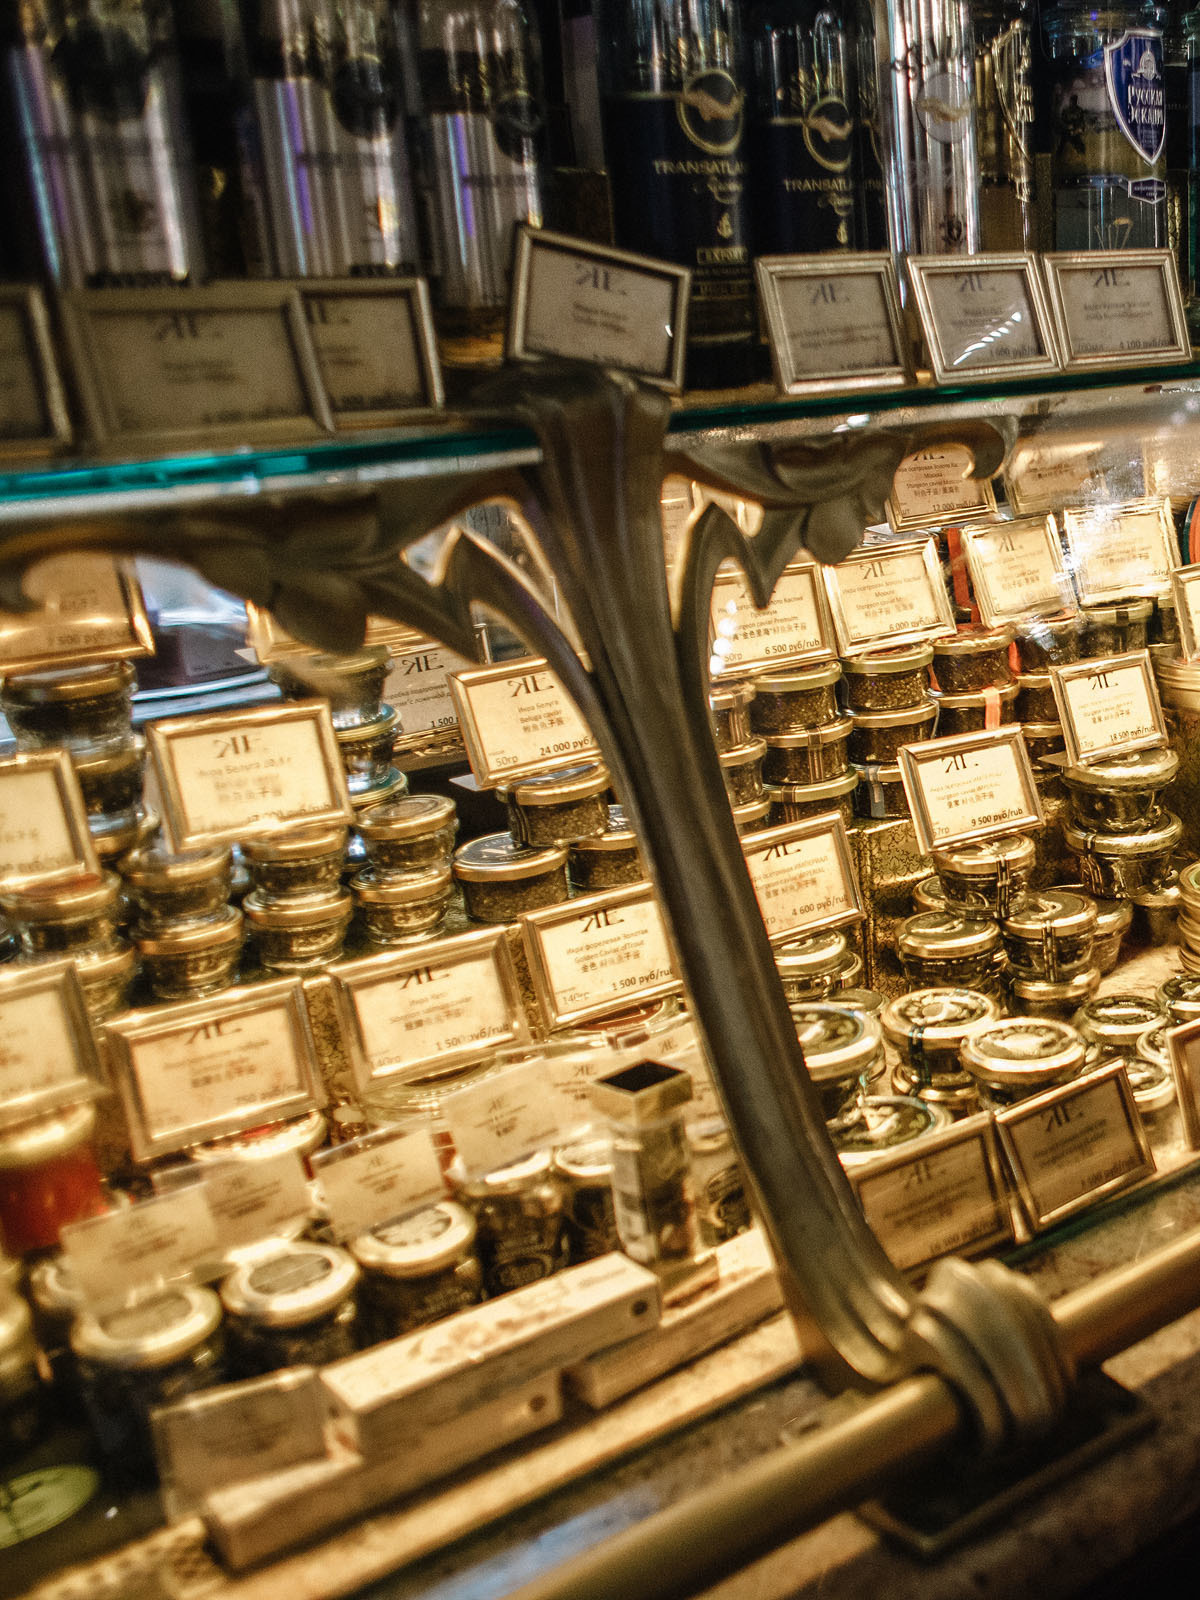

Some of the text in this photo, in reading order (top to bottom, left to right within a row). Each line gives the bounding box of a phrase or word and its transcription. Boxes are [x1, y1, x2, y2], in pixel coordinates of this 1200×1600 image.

[764, 639, 820, 655] 6 500 руб/rub
[438, 716, 454, 727] 500
[539, 735, 595, 757] 24 000 руб/
[971, 818, 977, 828] 9
[978, 814, 992, 826] 500
[799, 903, 815, 914] 600
[611, 982, 618, 991] 1
[619, 976, 637, 989] 500
[444, 1035, 466, 1049] 50
